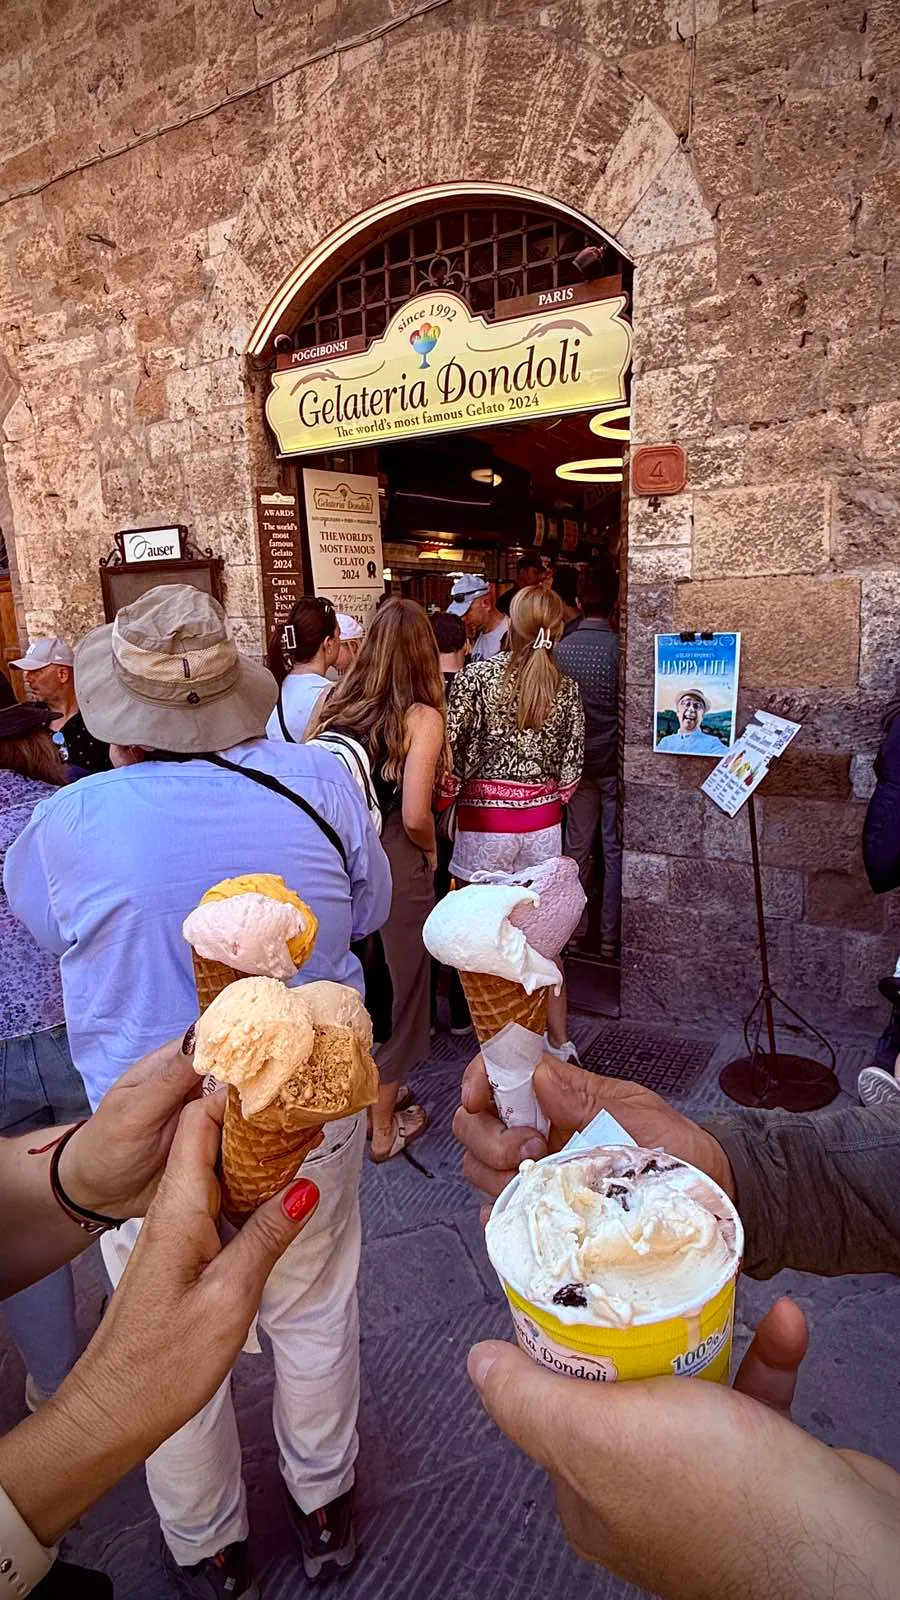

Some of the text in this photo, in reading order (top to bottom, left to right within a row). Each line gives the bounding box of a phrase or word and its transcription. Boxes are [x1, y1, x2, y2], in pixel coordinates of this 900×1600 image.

[538, 287, 574, 306] PARIS
[397, 303, 458, 333] since 1992
[291, 340, 349, 363] POGGIBONSI
[299, 338, 582, 428] Gelateria Dondoli
[334, 393, 540, 439] The world's most famous Gelato 2024
[649, 461, 664, 477] 4
[263, 509, 295, 517] AWARDS
[262, 522, 298, 531] The world's
[272, 531, 290, 540] most
[319, 531, 374, 543] THE WORLD'S
[269, 539, 294, 548] famous
[147, 545, 175, 558] auser
[270, 548, 294, 557] Gelato
[319, 545, 376, 555] MOST FAMOUS
[273, 559, 293, 569] 2024
[333, 557, 365, 567] GELATO
[341, 569, 360, 580] 2024
[661, 658, 729, 676] HAPPY LIFE
[672, 1332, 722, 1371] 100%
[539, 1345, 608, 1383] Dondoli
